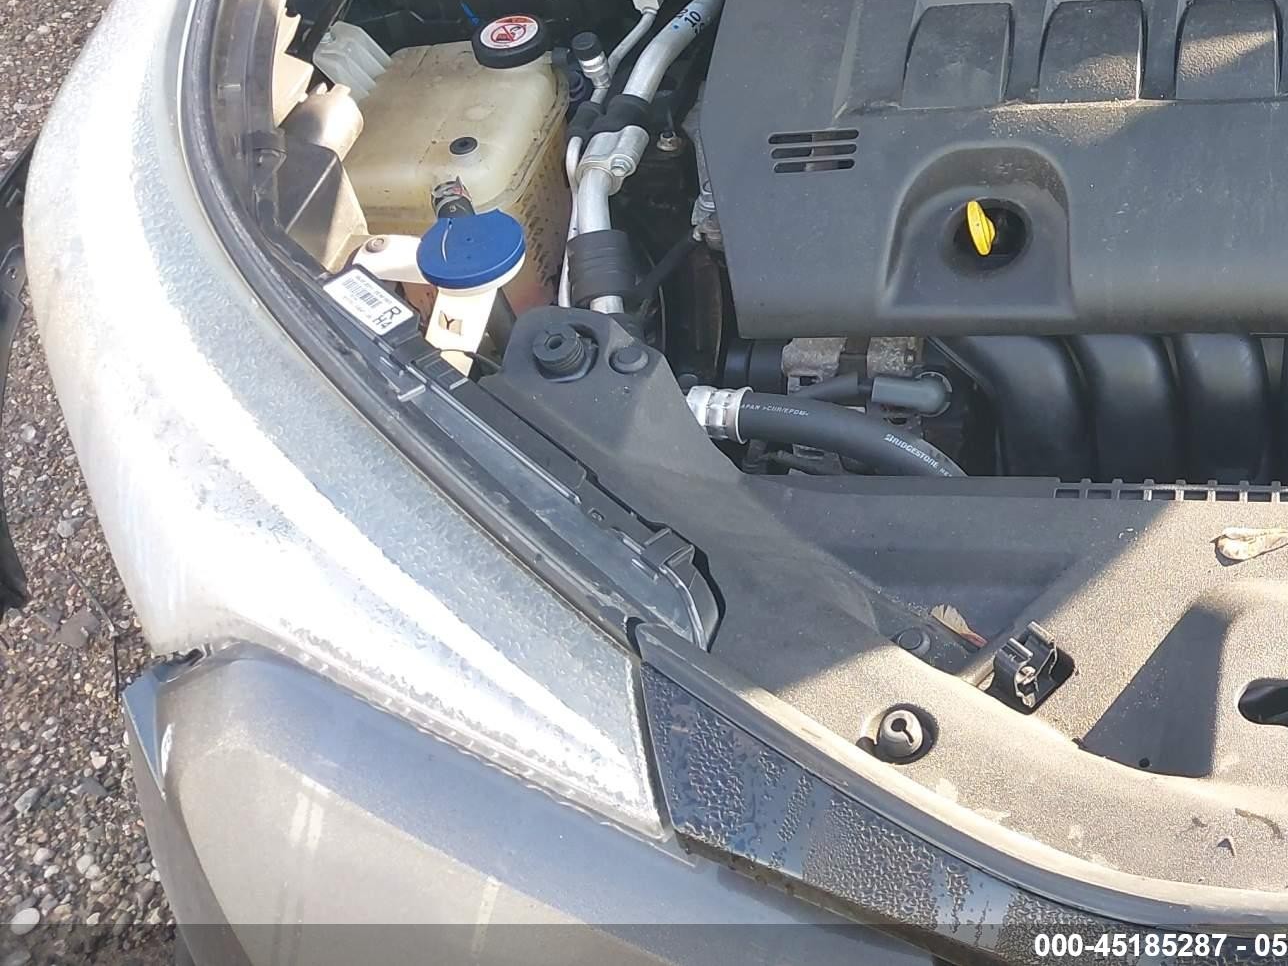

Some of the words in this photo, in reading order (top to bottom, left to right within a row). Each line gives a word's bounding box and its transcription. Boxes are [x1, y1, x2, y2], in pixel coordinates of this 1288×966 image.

[684, 11, 701, 28] 10
[383, 306, 402, 320] R
[884, 434, 939, 468] BRIDGESTONE
